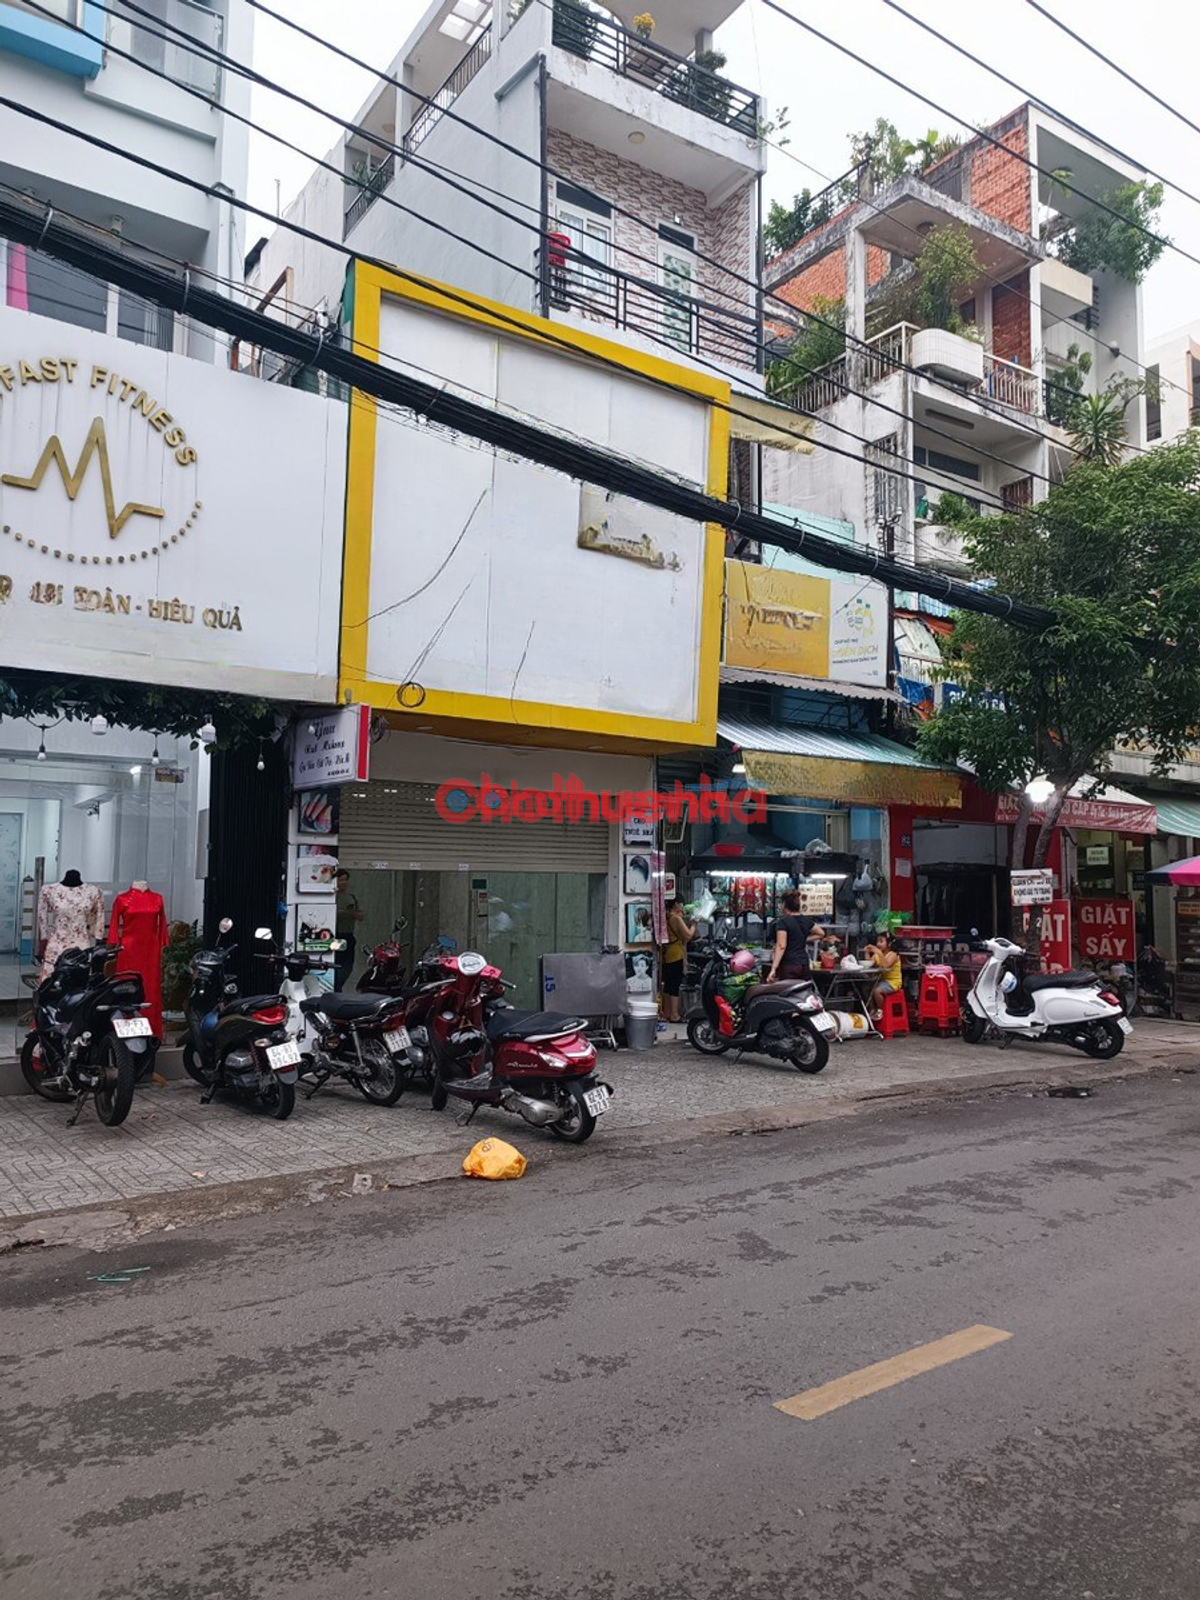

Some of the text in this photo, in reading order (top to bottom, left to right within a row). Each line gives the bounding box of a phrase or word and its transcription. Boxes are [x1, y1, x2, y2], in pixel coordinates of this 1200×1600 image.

[90, 364, 199, 467] FITNESS
[202, 605, 243, 632] QUẢ
[1081, 903, 1130, 929] GIẶT
[1086, 931, 1126, 956] SẤY
